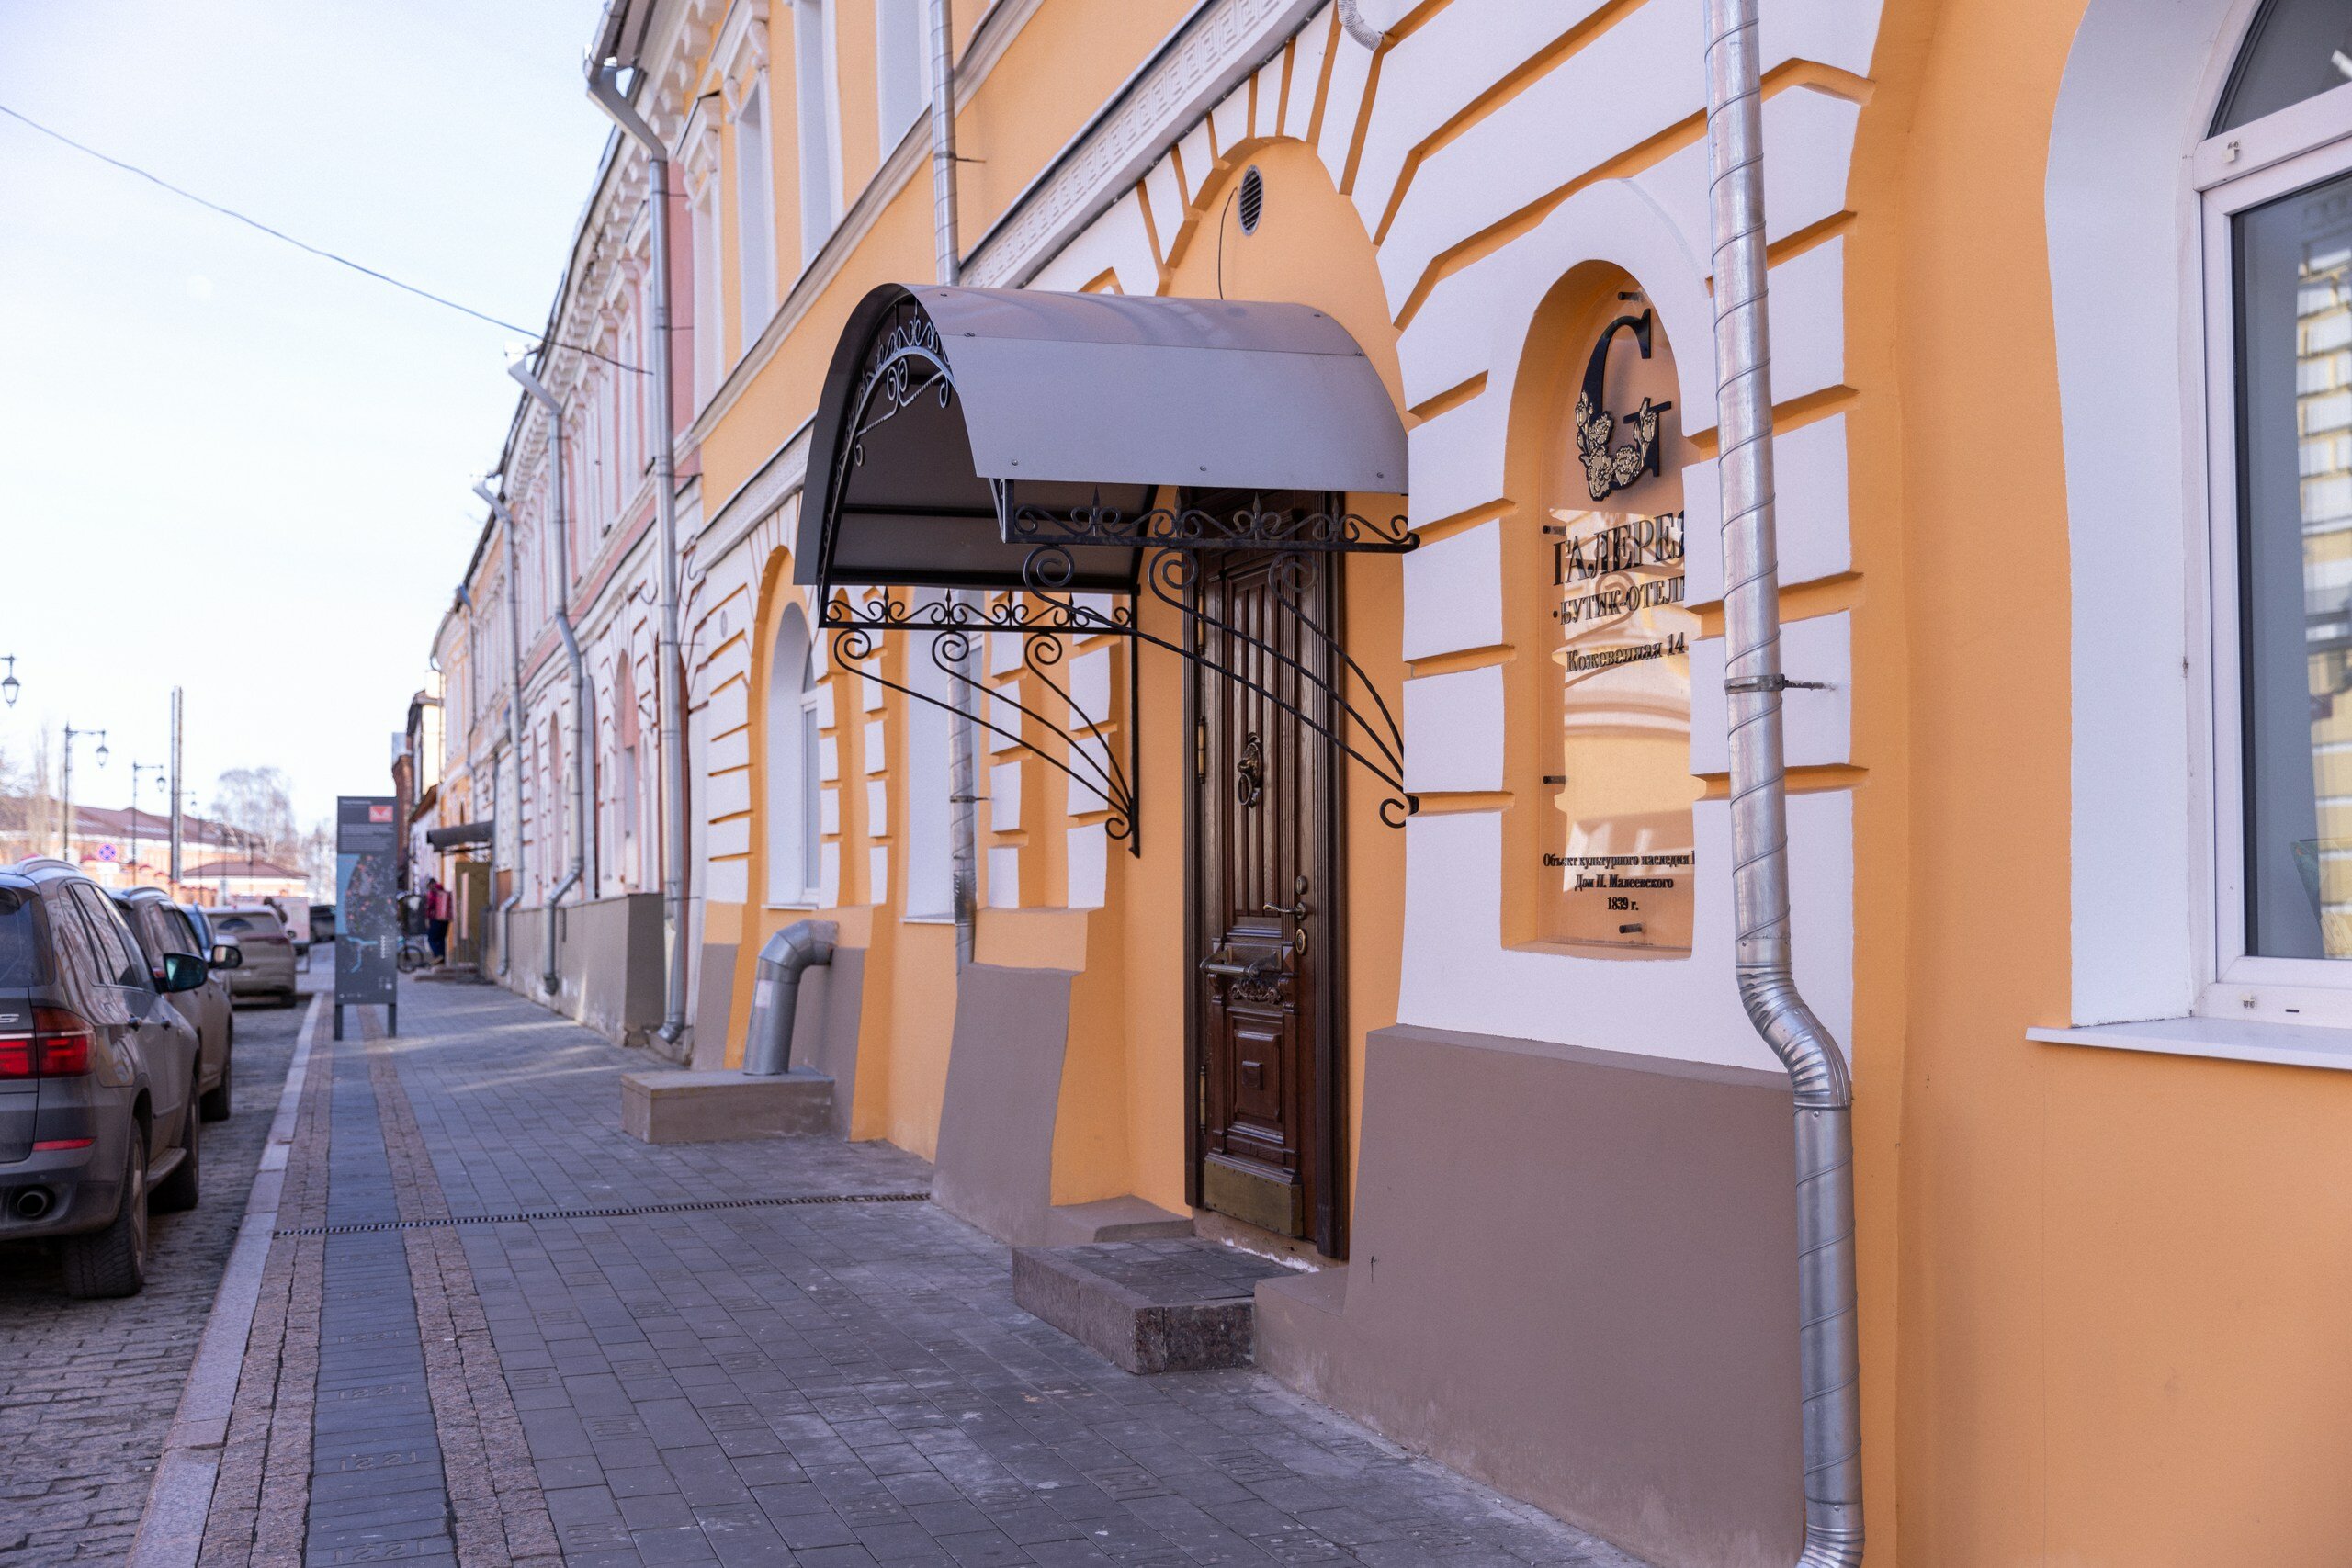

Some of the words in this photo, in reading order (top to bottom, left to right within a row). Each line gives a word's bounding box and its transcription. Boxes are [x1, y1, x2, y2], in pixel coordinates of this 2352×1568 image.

[1566, 642, 1662, 672] Кожевенная
[1667, 632, 1684, 656] 14
[1544, 853, 1577, 867] Объект
[1579, 855, 1639, 870] культурного
[1641, 854, 1689, 868] наследия
[1575, 874, 1594, 891] Дом
[1607, 897, 1628, 911] 1839
[1630, 900, 1639, 911] г.
